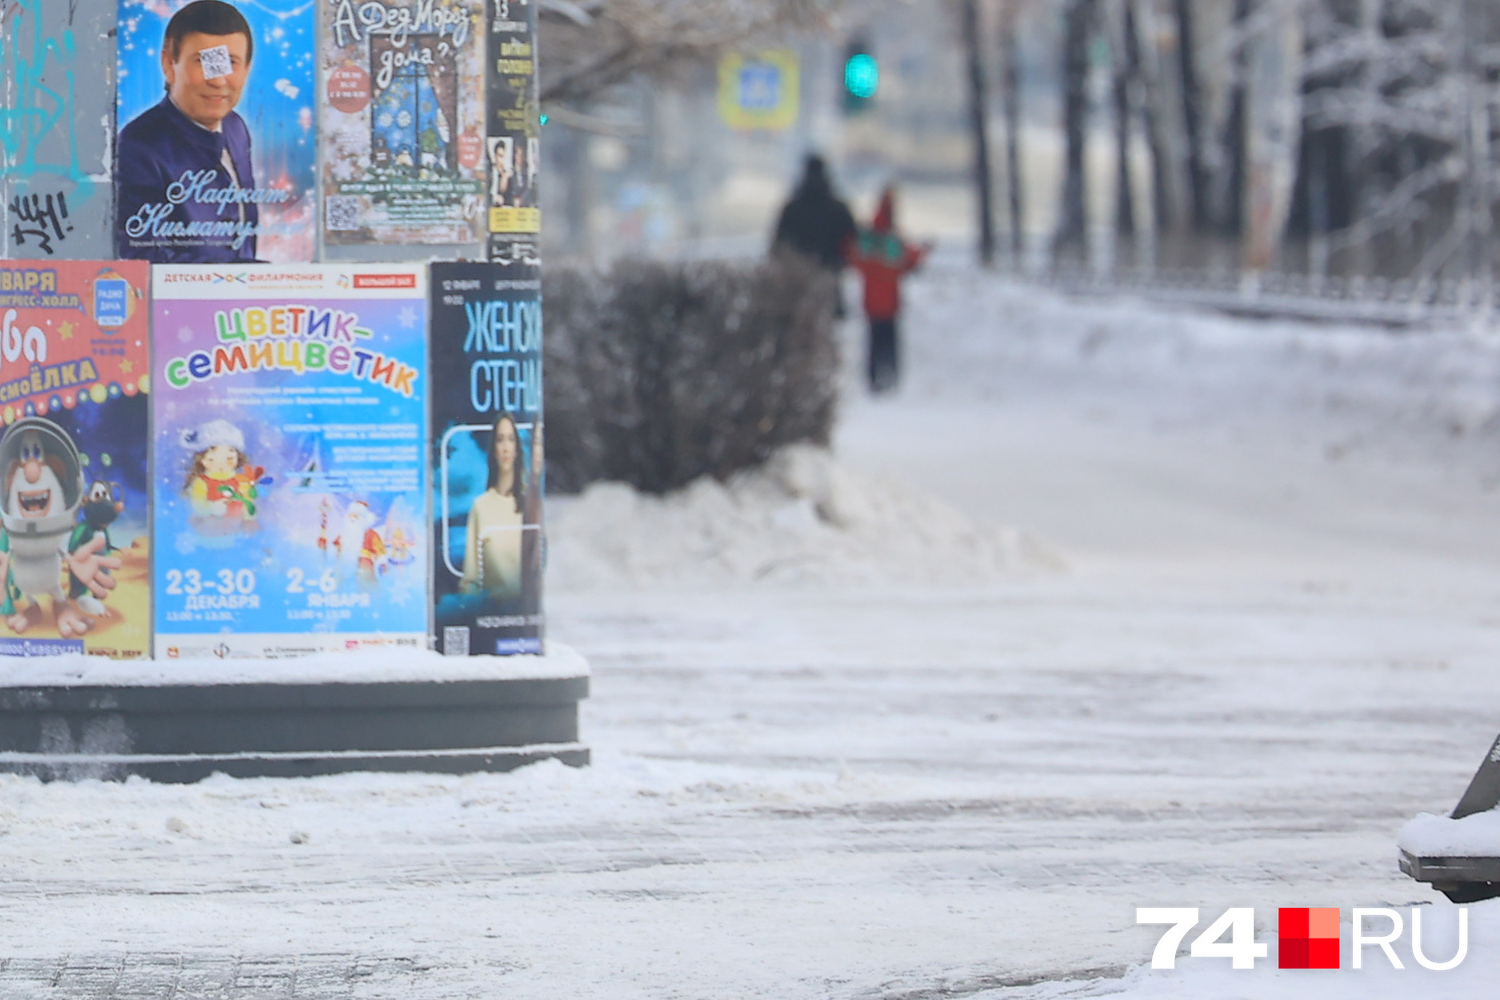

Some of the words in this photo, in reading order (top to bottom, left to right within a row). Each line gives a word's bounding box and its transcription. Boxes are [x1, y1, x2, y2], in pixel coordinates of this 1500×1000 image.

[359, 1, 412, 48] Дед
[217, 308, 371, 342] ЦВЕТИК-
[166, 568, 256, 595] 23-30
[285, 567, 337, 593] 2-6
[184, 594, 260, 611] ДЕКАБРЯ
[307, 592, 370, 608] ЯНВАРЯ
